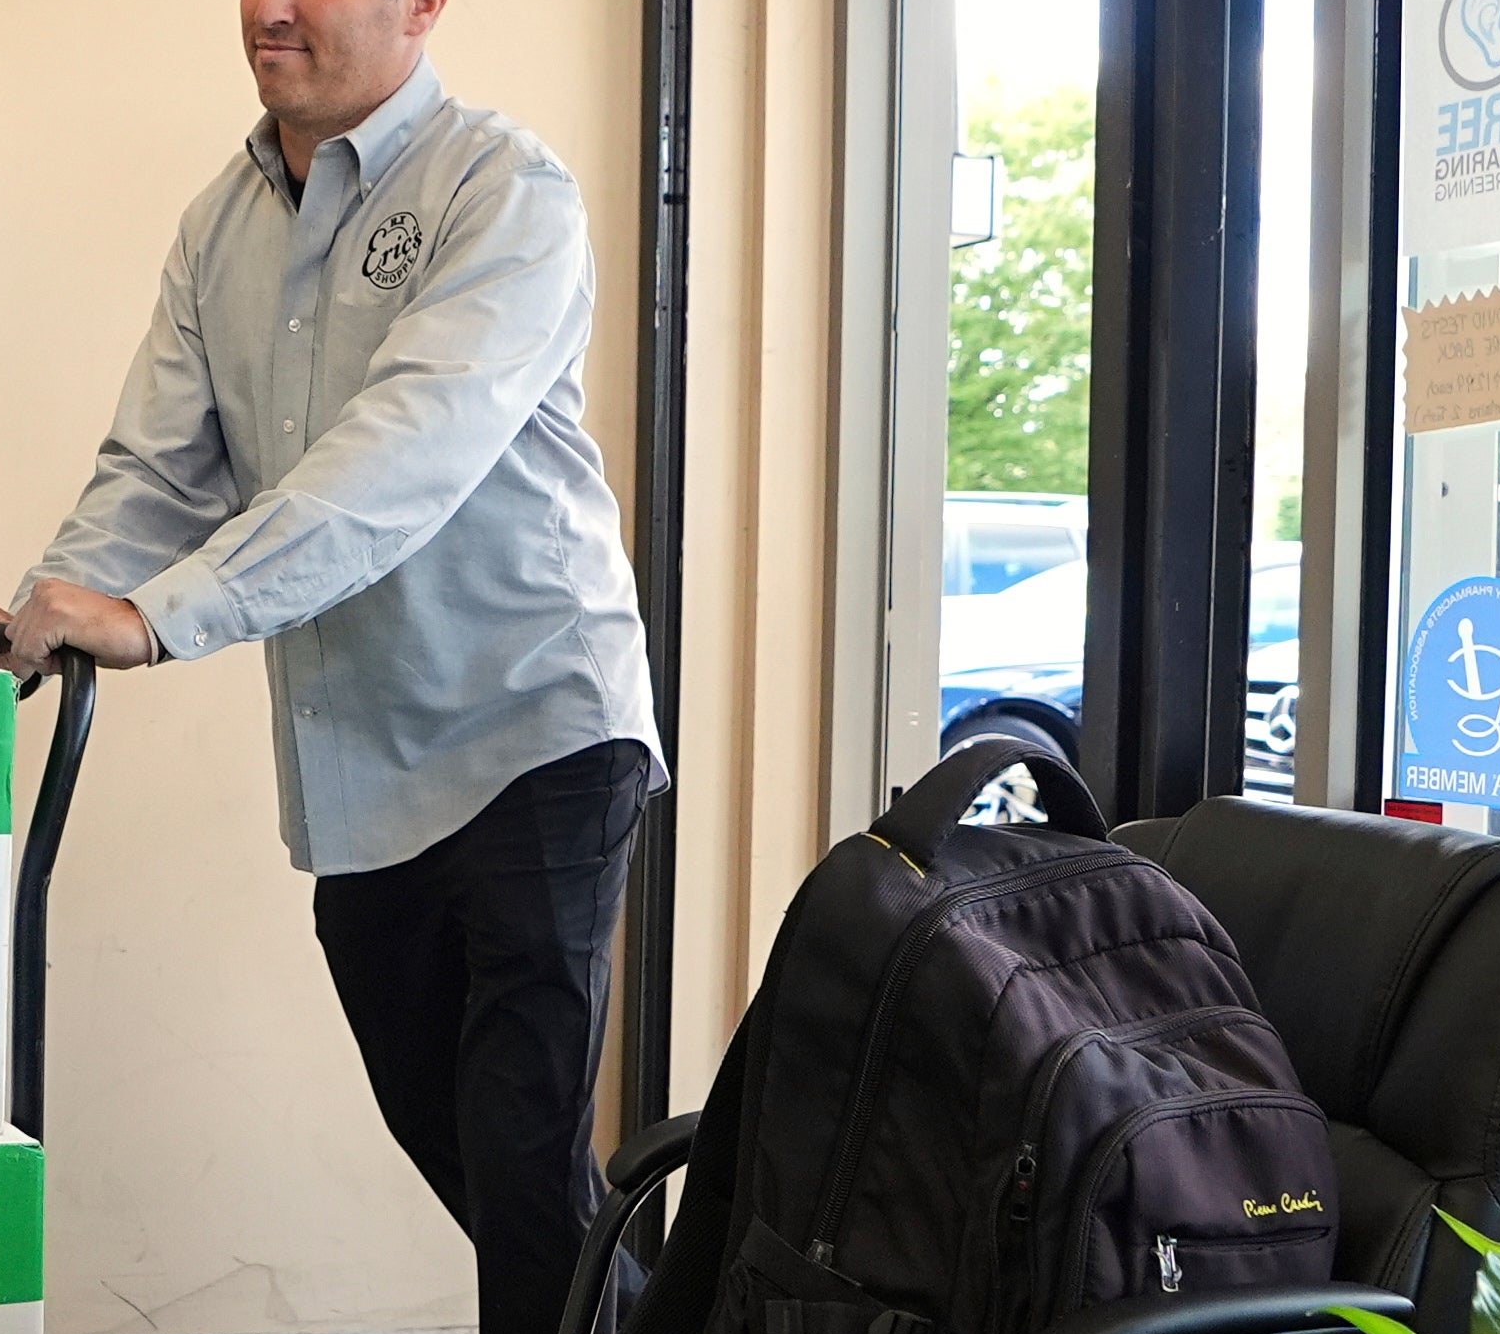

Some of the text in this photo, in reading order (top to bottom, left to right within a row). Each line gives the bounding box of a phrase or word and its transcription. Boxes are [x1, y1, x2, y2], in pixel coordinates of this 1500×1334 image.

[362, 226, 422, 278] Eric's
[374, 254, 415, 284] SHOPPE
[1280, 1189, 1324, 1214] Cardin
